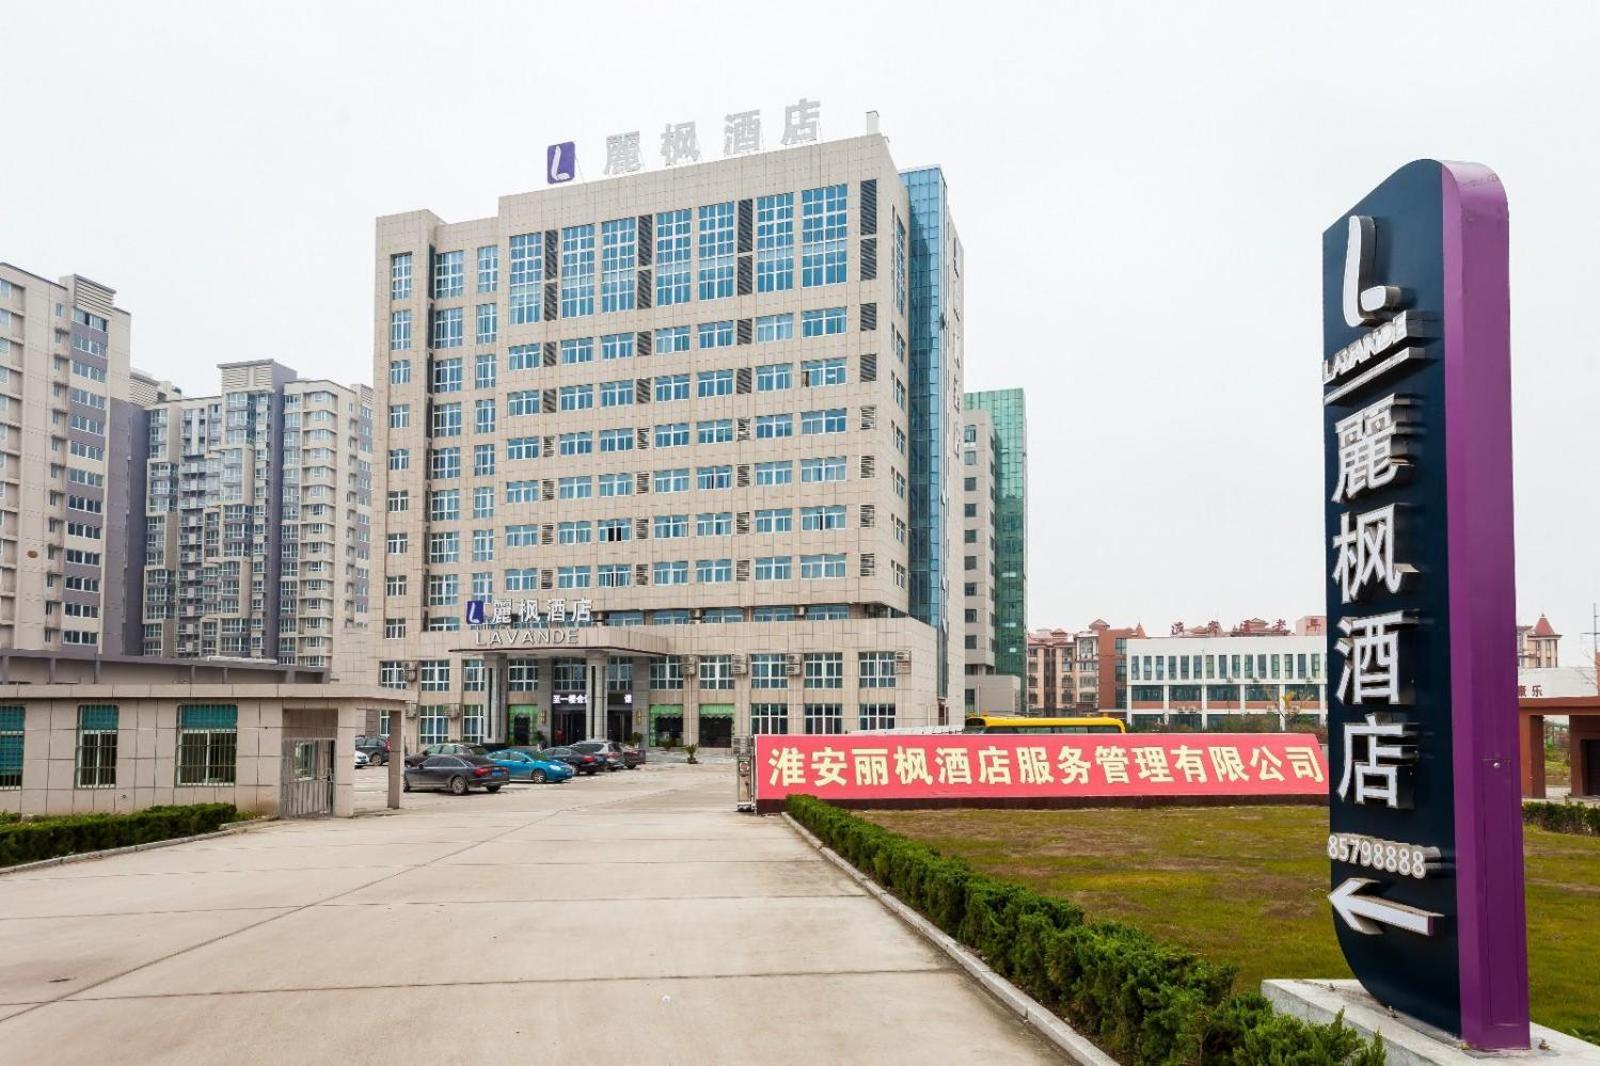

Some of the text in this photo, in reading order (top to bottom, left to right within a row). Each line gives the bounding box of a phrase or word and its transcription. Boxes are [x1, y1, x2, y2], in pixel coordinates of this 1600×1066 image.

[1322, 310, 1408, 384] LAVANDE
[1332, 392, 1406, 809] 麗枫酒店
[475, 628, 580, 646] LAVANDE
[767, 745, 1326, 787] 淮安丽枫酒店服务管理有限公司
[1327, 833, 1427, 880] 85798888
